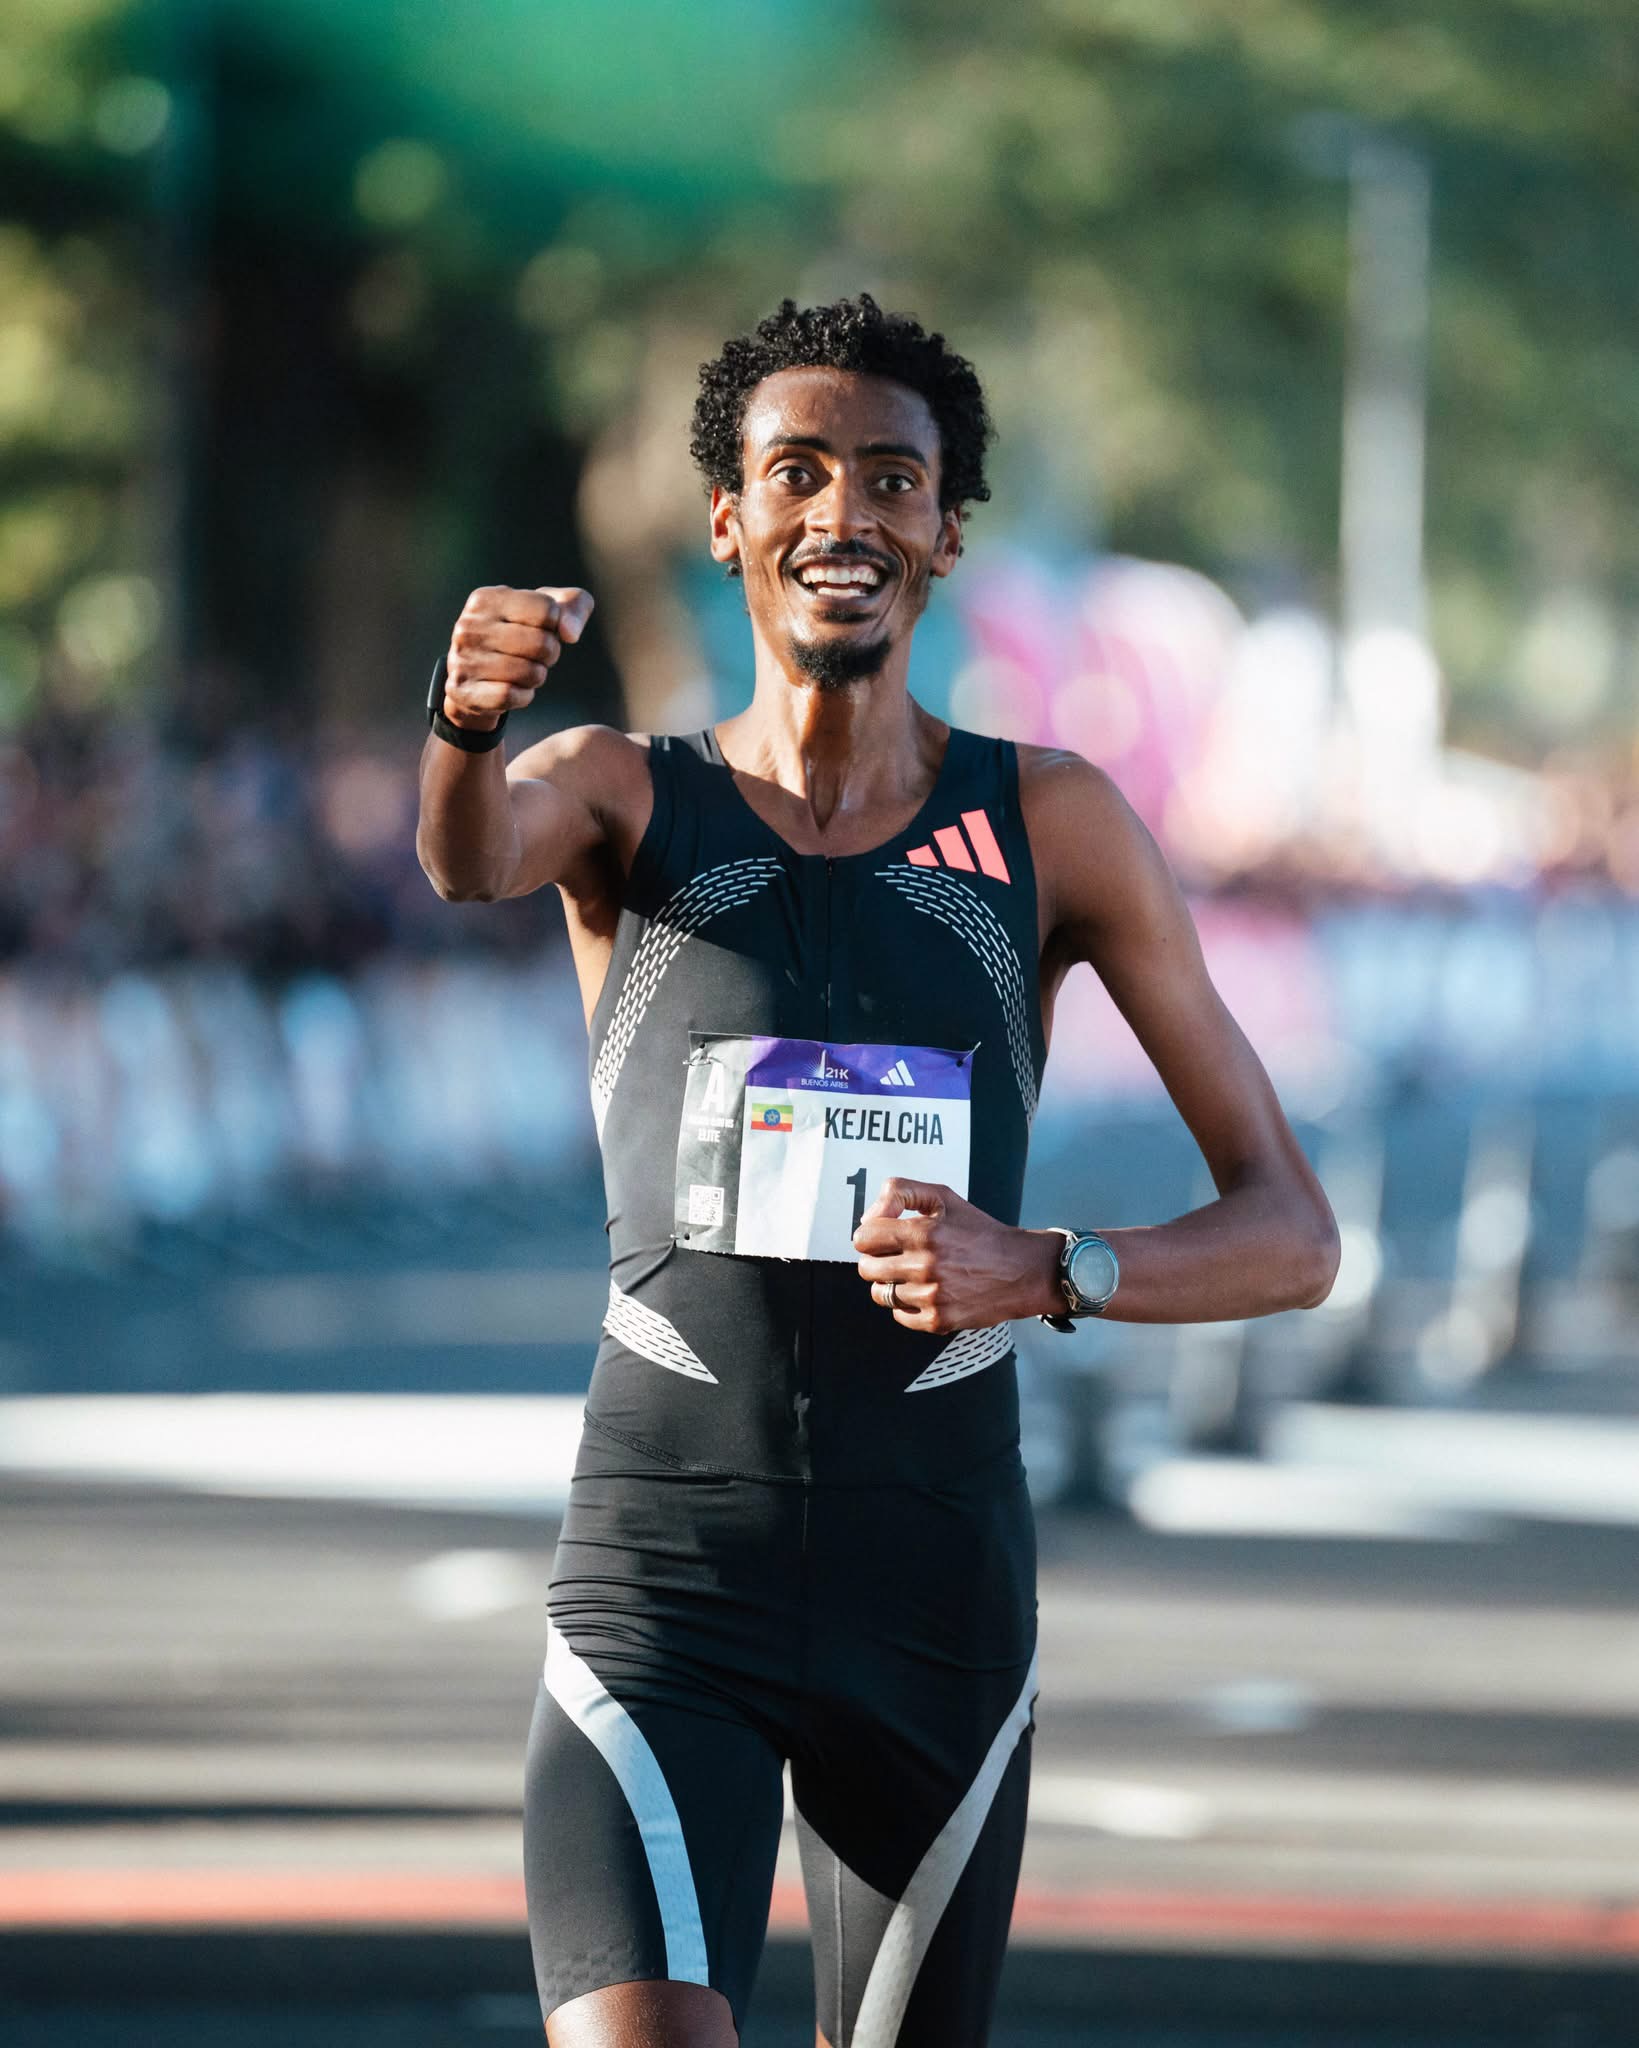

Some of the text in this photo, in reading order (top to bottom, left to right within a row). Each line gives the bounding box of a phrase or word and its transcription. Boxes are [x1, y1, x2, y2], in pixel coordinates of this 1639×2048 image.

[801, 1078, 849, 1089] BUENOS AIRES
[825, 1067, 849, 1080] 21K
[824, 1107, 944, 1145] KEJELCHA
[846, 1167, 867, 1241] 1
